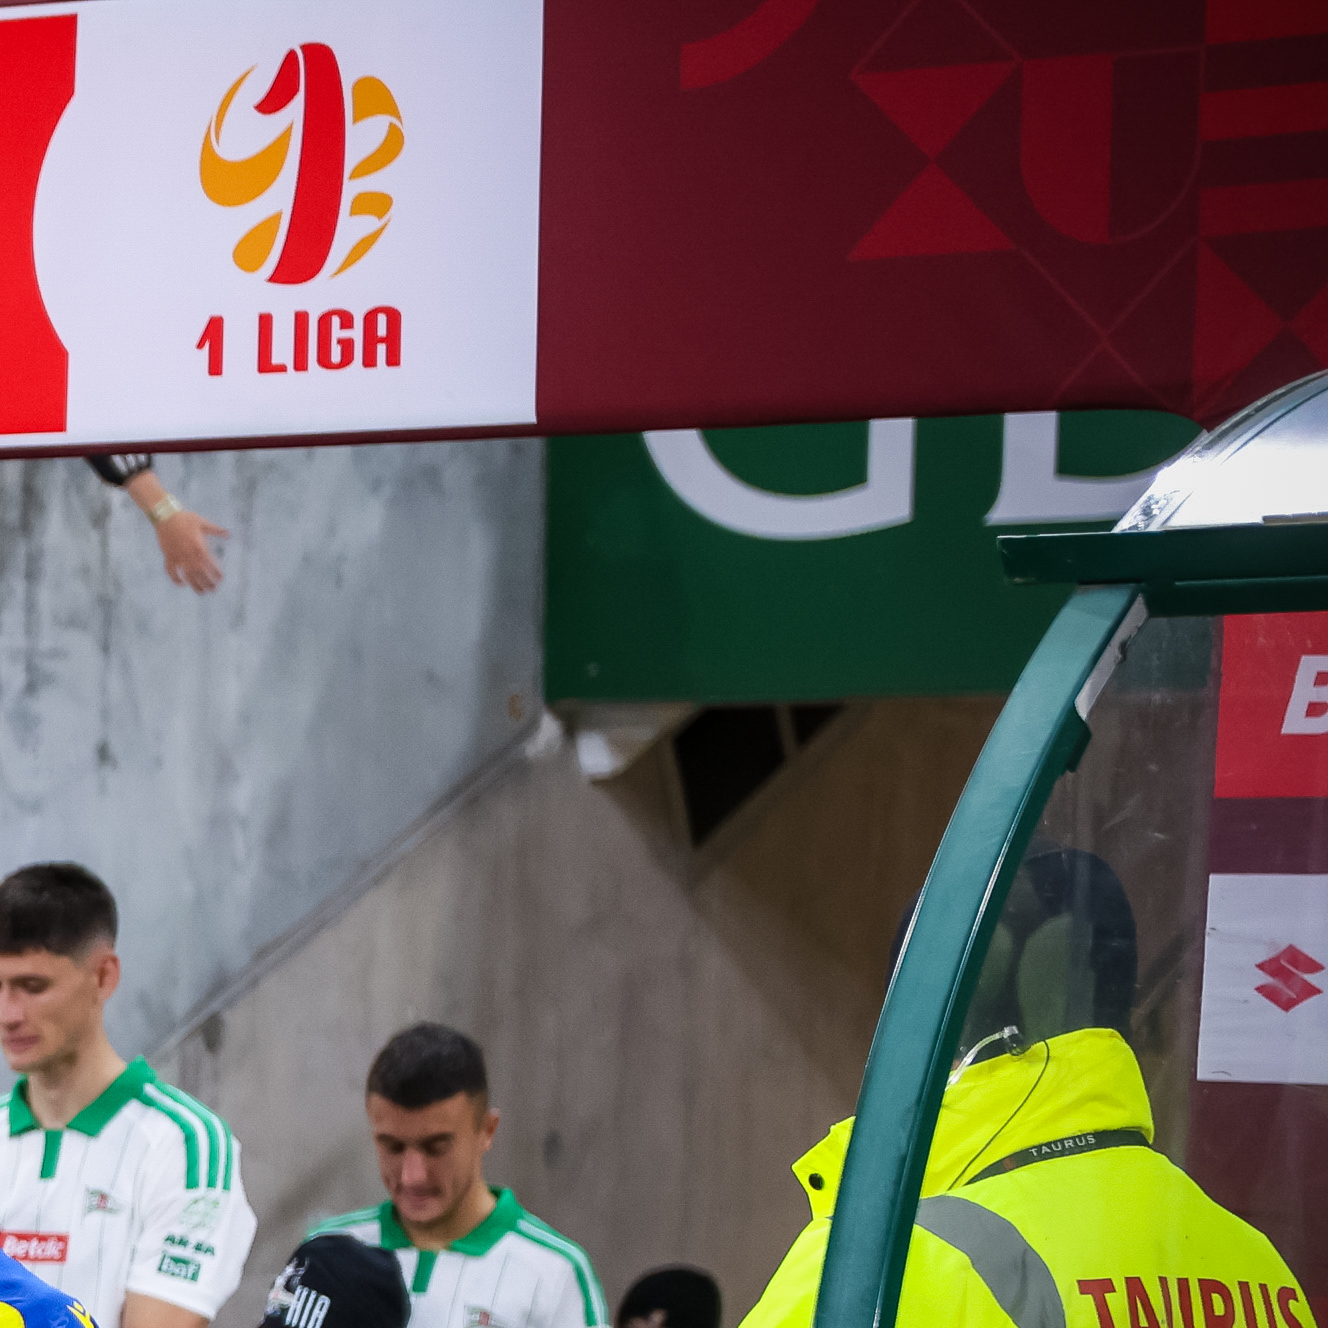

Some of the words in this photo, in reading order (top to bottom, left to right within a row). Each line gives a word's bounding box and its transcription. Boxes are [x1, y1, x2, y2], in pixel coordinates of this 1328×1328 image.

[195, 315, 224, 376] 1
[257, 305, 403, 374] LIGA
[1029, 1133, 1097, 1158] TAURUS
